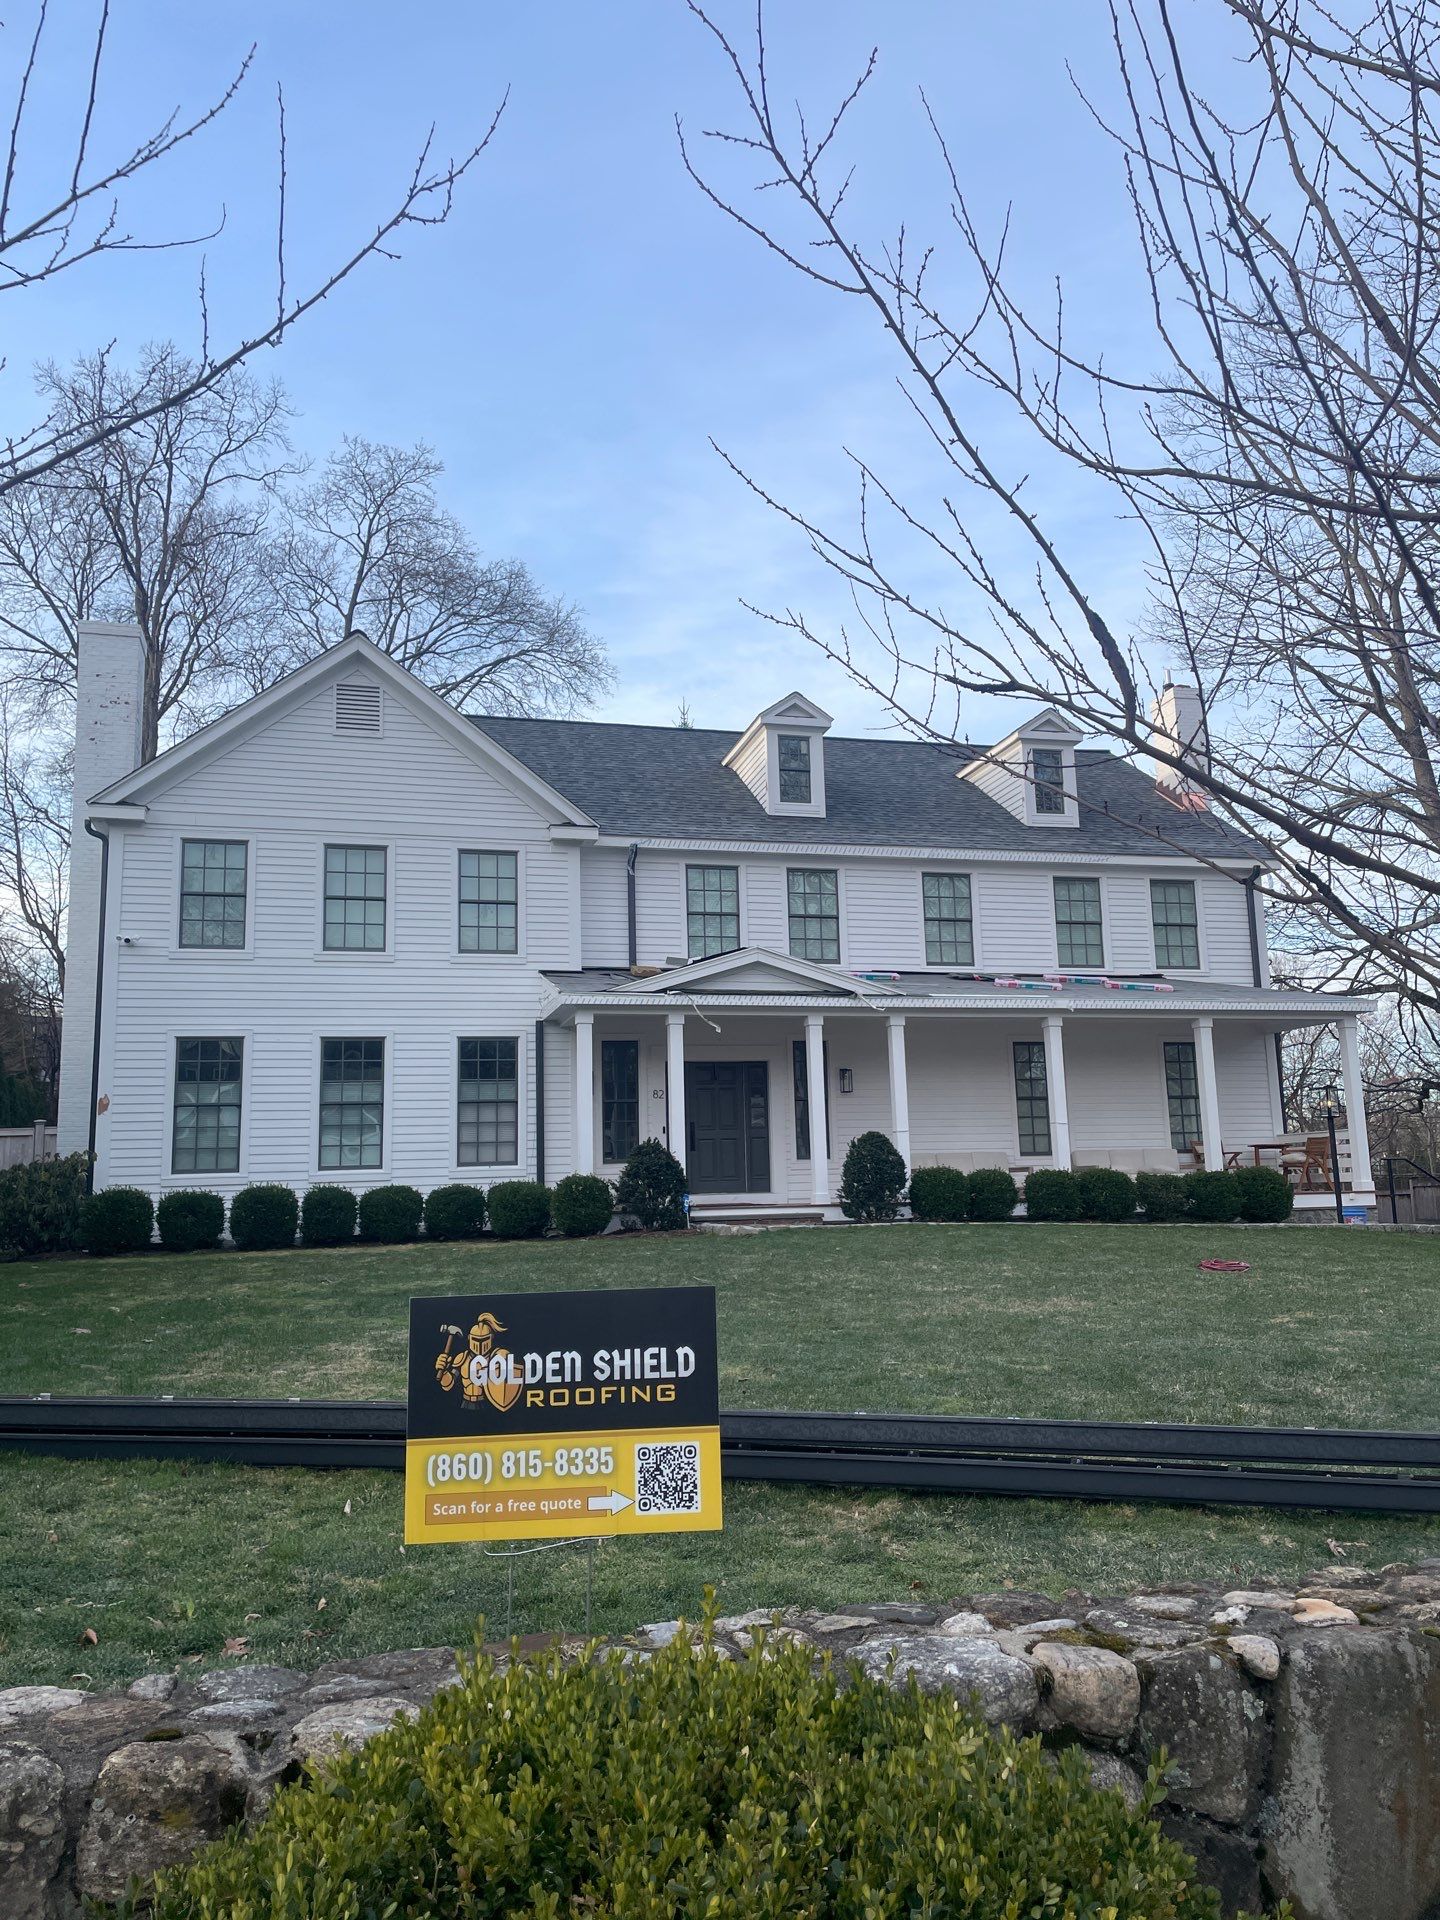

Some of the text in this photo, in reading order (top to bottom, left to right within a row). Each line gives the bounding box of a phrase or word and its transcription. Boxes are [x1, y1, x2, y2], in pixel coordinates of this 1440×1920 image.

[653, 1089, 664, 1100] 82
[470, 1345, 696, 1387] GOLDEN SHIELD
[526, 1384, 676, 1408] ROOFING
[427, 1446, 614, 1487] (860) 815-8335
[433, 1499, 582, 1516] Scan for a free quote
